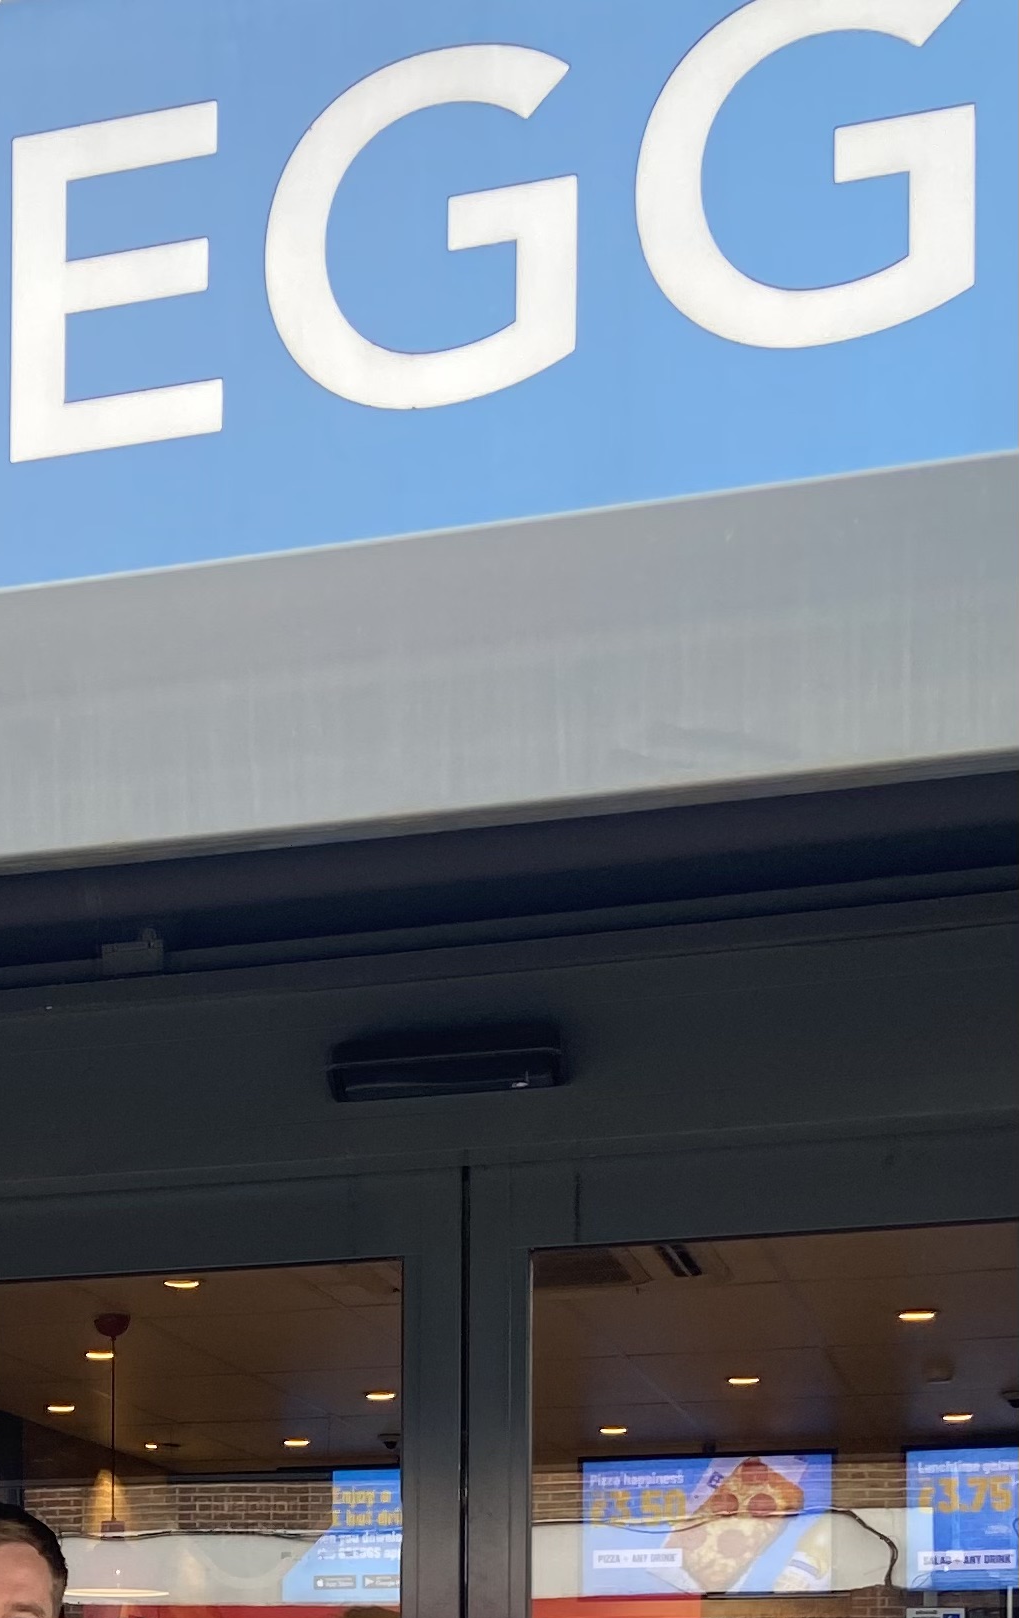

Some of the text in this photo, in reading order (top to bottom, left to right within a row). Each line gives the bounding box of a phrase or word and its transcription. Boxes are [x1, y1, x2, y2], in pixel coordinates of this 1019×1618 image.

[589, 1471, 685, 1488] Pizza happiness
[963, 1555, 981, 1565] ANY
